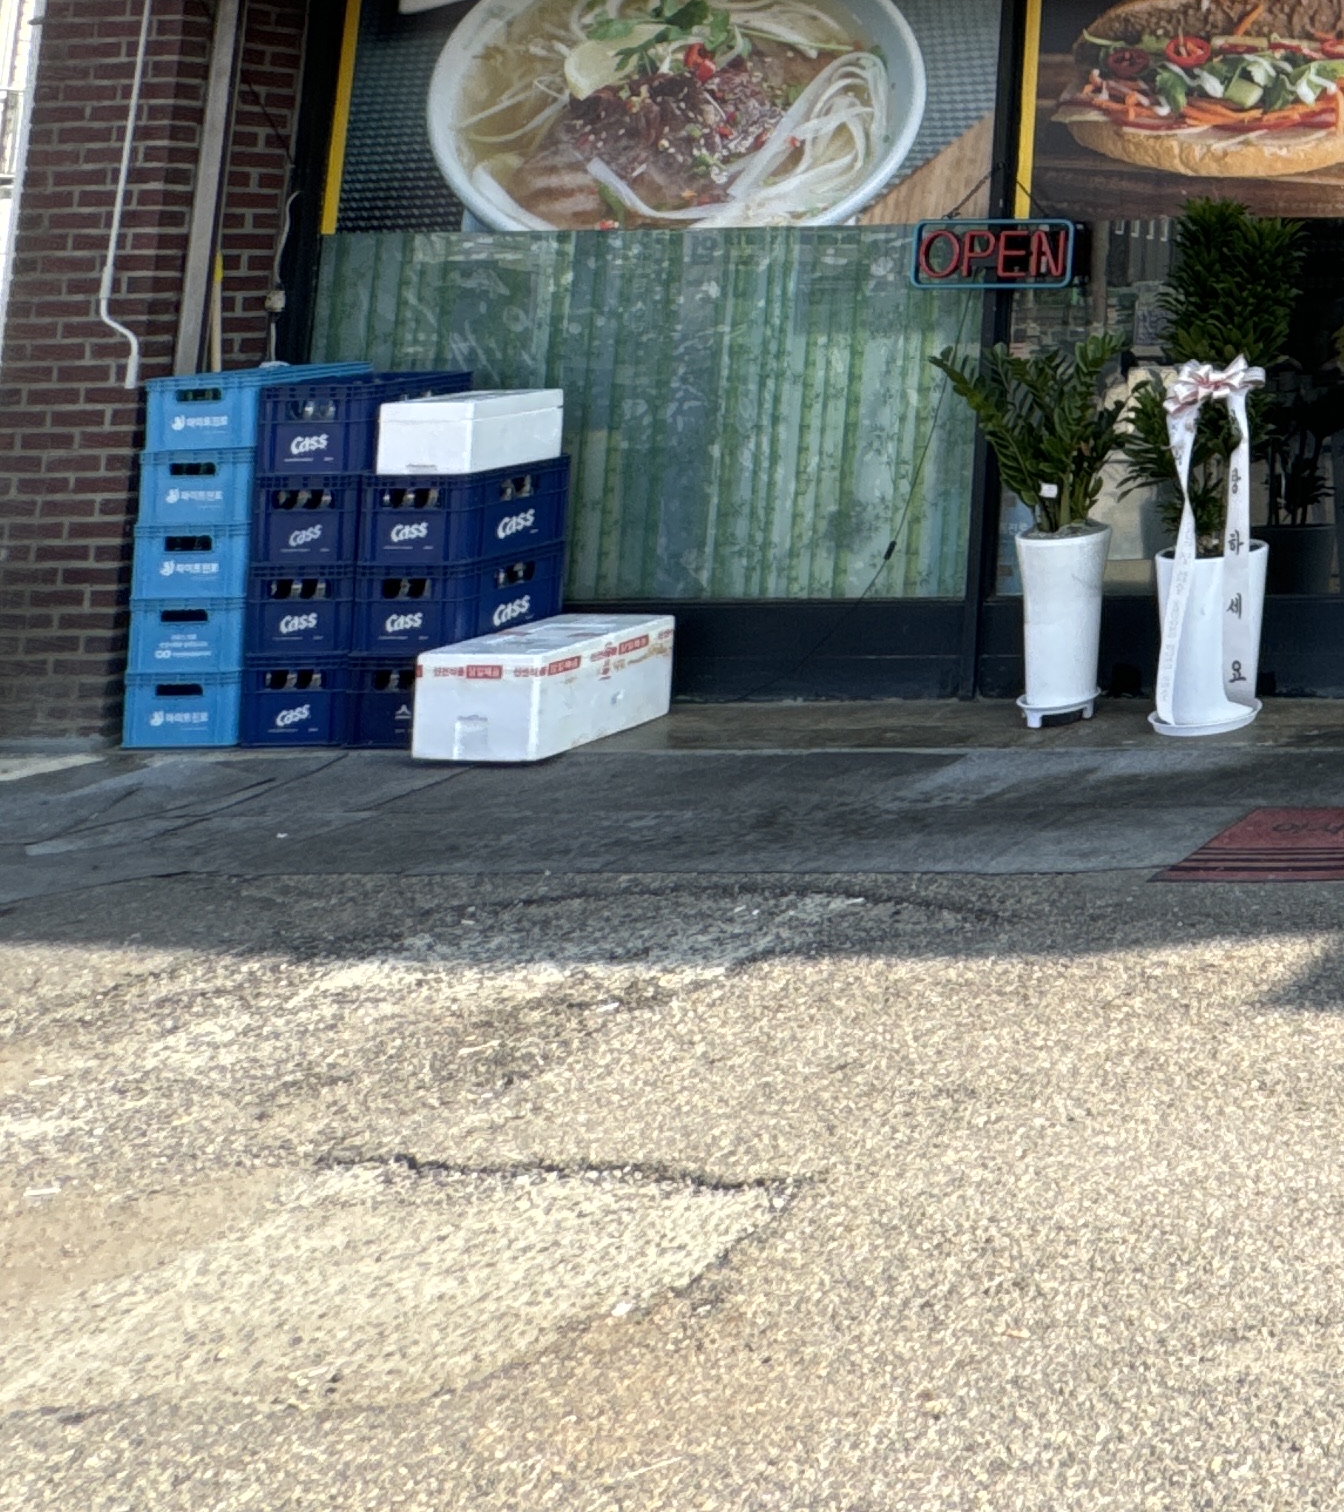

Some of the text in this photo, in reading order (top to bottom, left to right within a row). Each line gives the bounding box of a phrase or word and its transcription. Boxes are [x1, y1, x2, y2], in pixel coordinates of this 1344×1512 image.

[918, 229, 1067, 278] OPEN
[290, 433, 329, 455] Cass
[391, 522, 429, 543] Cass
[497, 508, 535, 539] Cass
[288, 524, 322, 547] Cass
[385, 612, 423, 633] Cass
[493, 595, 531, 627] Cass
[279, 612, 318, 634] Cass
[275, 703, 311, 727] Cass
